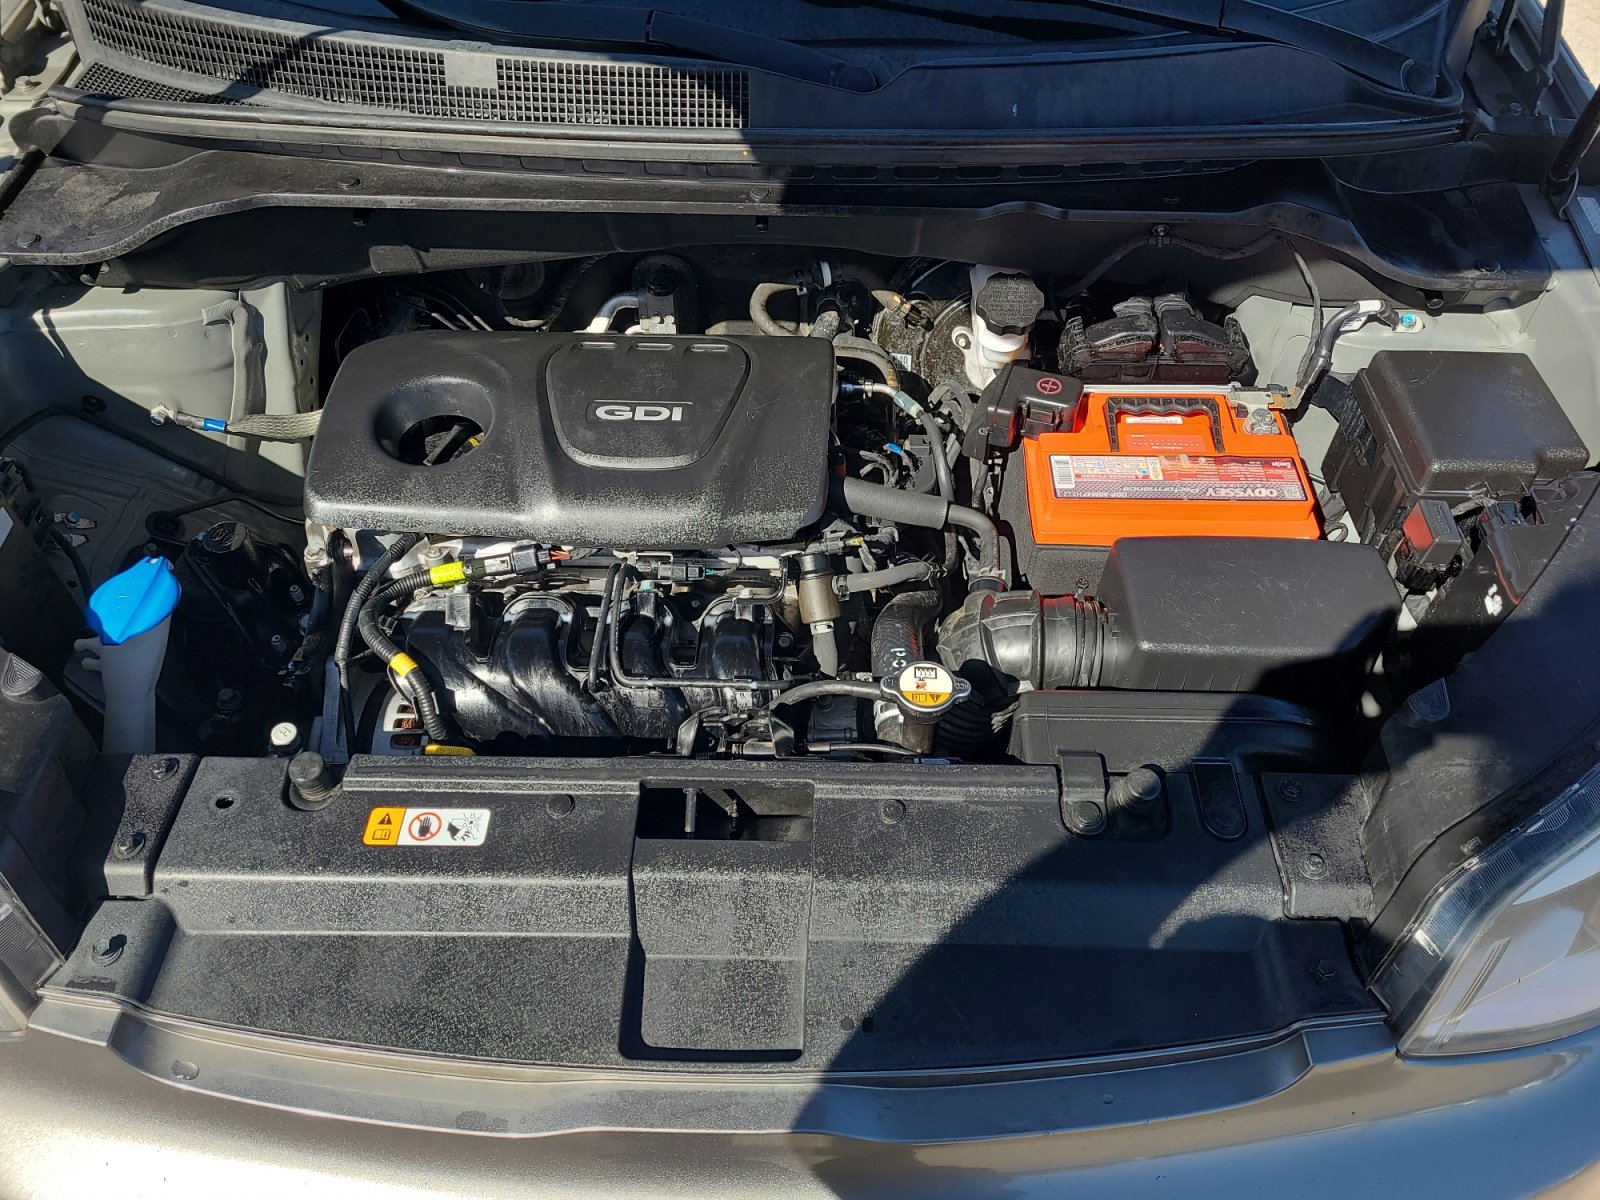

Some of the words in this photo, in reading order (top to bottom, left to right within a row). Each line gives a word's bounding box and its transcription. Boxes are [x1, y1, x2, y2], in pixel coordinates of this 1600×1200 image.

[595, 404, 684, 421] GDI
[1122, 485, 1200, 494] Performance
[1205, 487, 1278, 497] ODYSSEY
